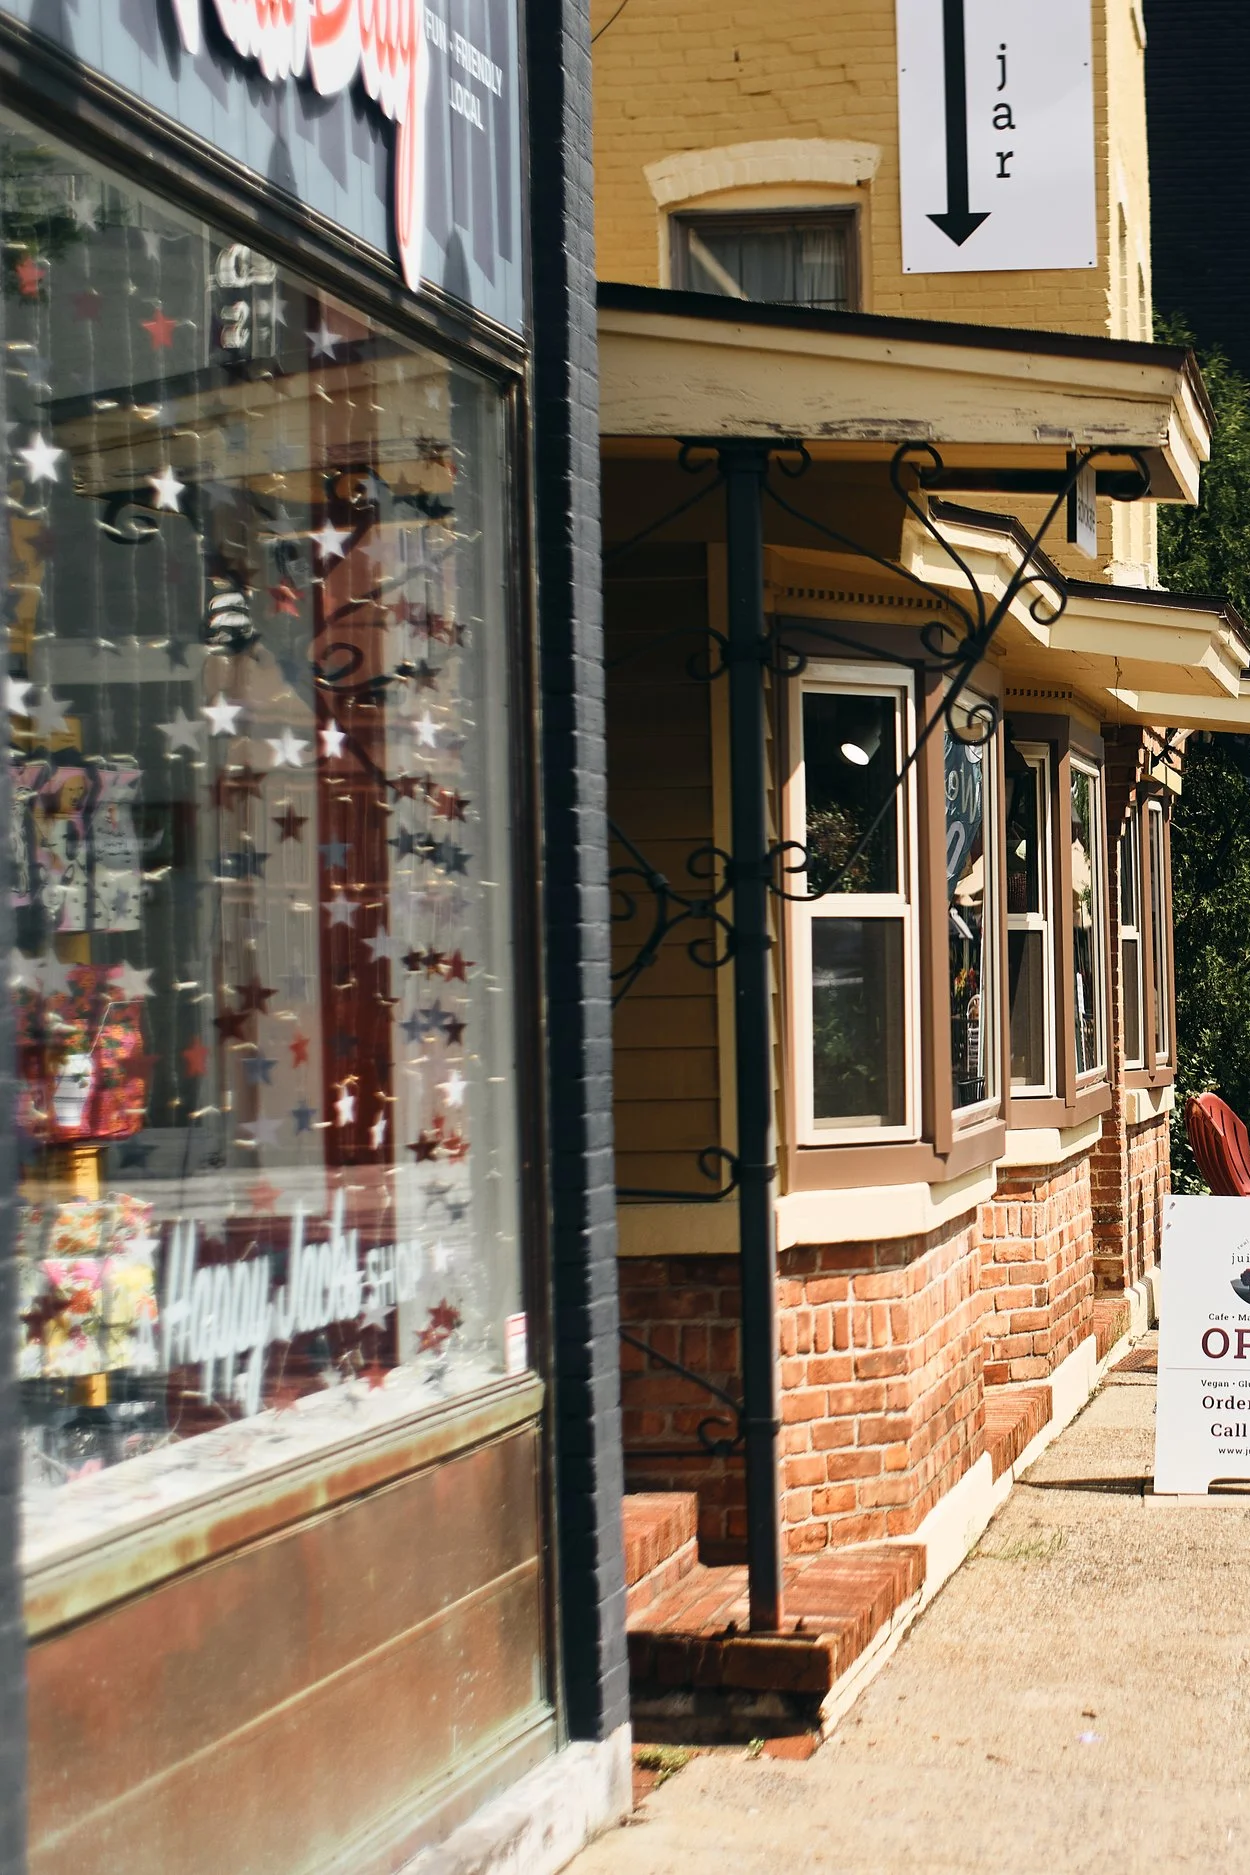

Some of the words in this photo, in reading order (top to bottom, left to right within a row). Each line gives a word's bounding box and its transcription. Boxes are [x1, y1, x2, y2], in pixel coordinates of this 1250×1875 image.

[424, 6, 447, 54] FUN
[452, 30, 502, 97] FRIENDLY
[450, 77, 485, 132] LOCAL
[991, 43, 1016, 178] jar
[1208, 1313, 1229, 1321] Cafe
[1200, 1380, 1230, 1389] Vegan
[1210, 1423, 1248, 1438] Call
